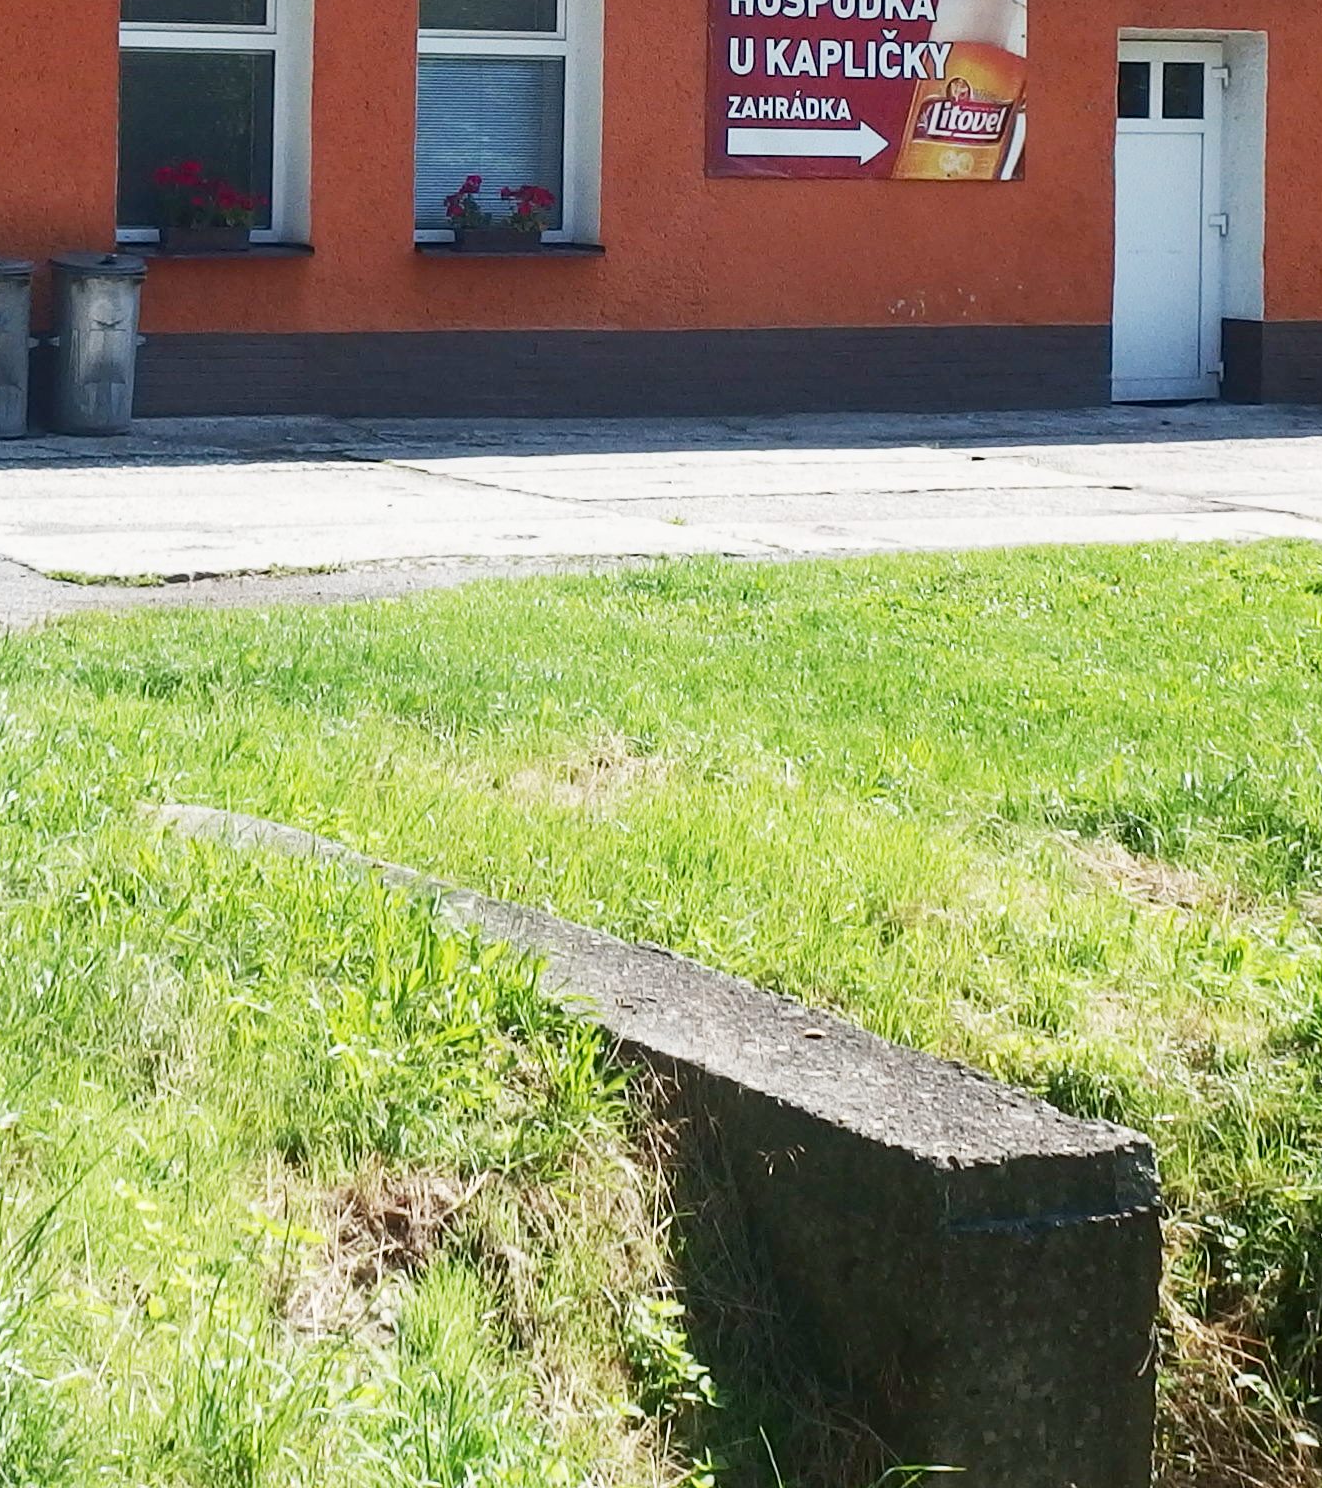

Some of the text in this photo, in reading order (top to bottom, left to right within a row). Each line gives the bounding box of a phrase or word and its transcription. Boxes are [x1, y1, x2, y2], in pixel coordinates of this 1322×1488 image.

[729, 29, 953, 79] U KAPLIČKY
[727, 90, 852, 121] ZAHRÁDKA
[927, 100, 1008, 136] Litovel
